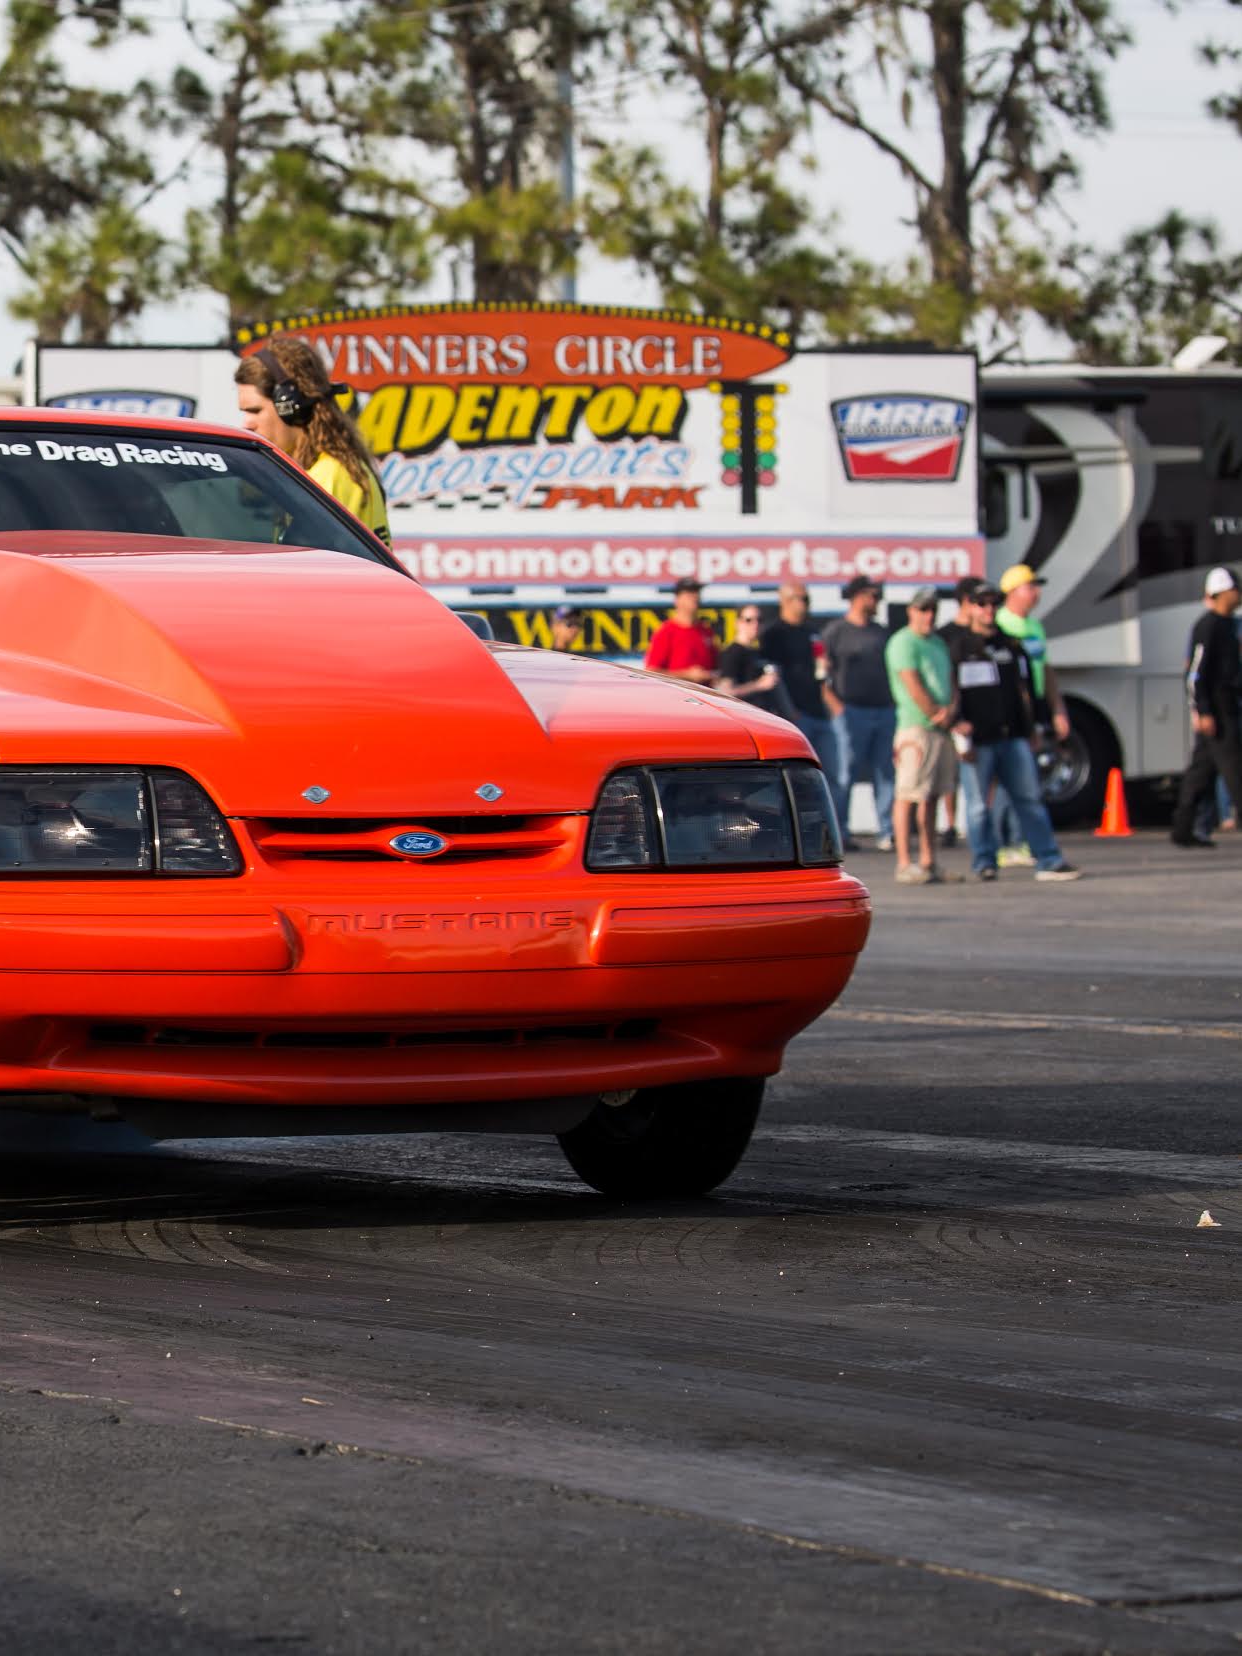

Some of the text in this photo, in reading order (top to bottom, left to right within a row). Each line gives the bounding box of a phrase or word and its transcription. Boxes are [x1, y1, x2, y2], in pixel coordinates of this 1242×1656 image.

[554, 334, 724, 376] CIRCLE
[335, 383, 685, 456] ADENTON
[35, 440, 119, 467] Drag
[115, 443, 228, 472] Racing
[540, 483, 706, 509] PARK
[403, 836, 434, 850] Ford
[307, 909, 575, 933] MUSTANG
